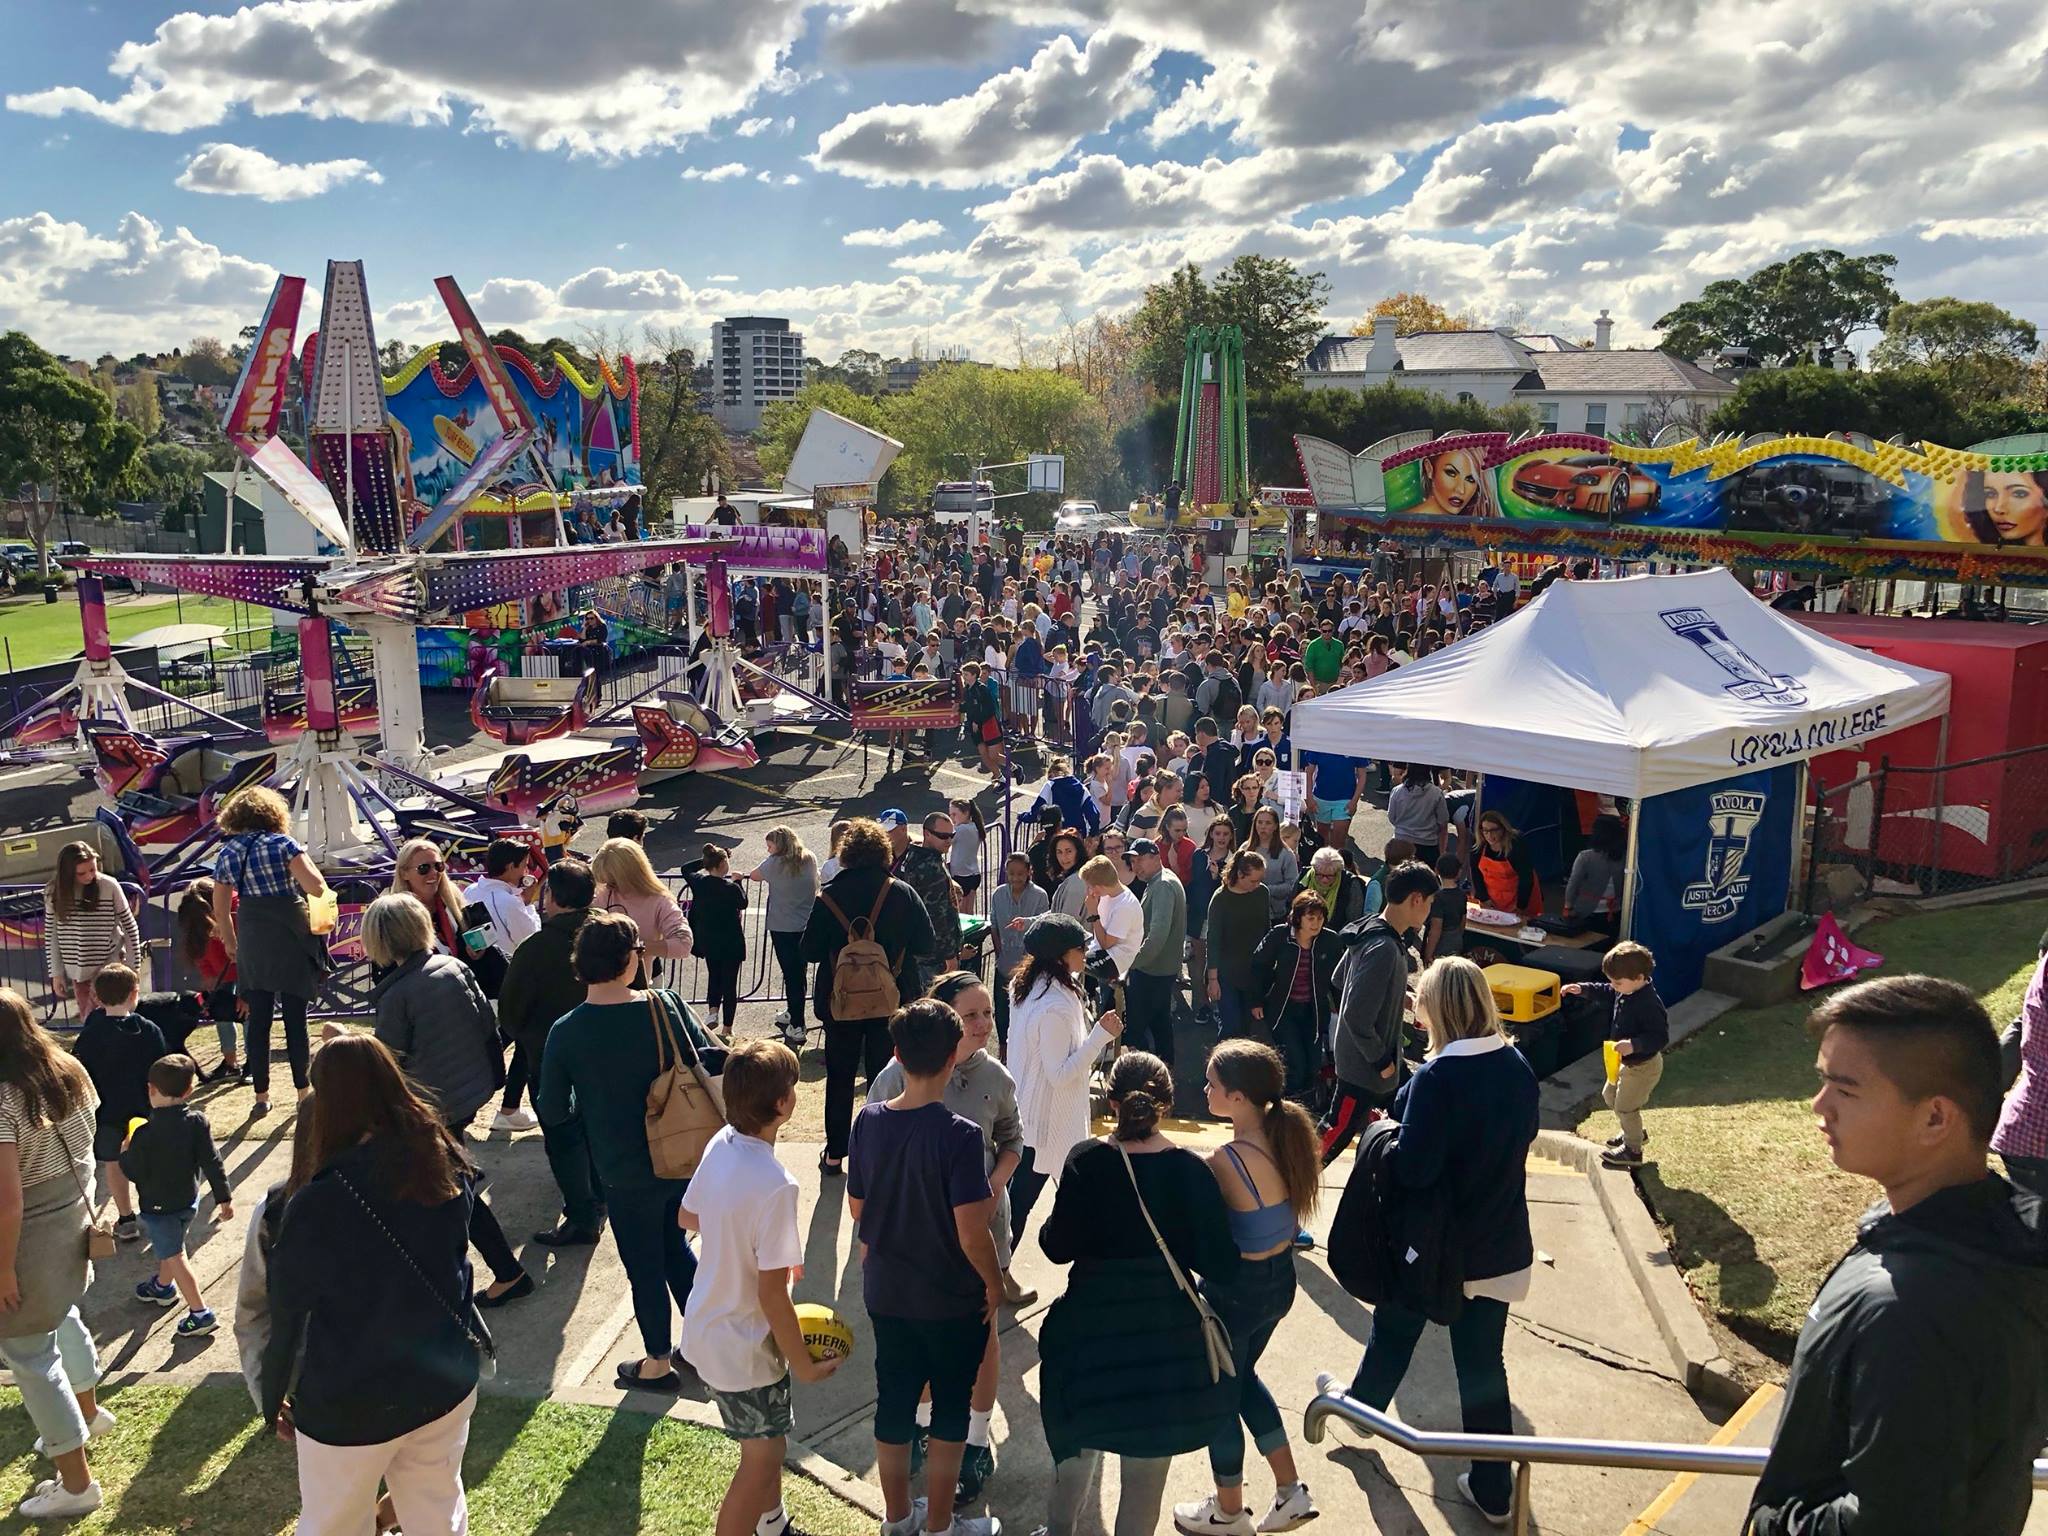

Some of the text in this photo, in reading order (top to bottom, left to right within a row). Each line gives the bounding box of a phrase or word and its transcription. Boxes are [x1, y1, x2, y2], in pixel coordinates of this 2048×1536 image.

[1731, 703, 1889, 767] LOYOLA COLLEGE
[1706, 903, 1728, 916] ERCY
